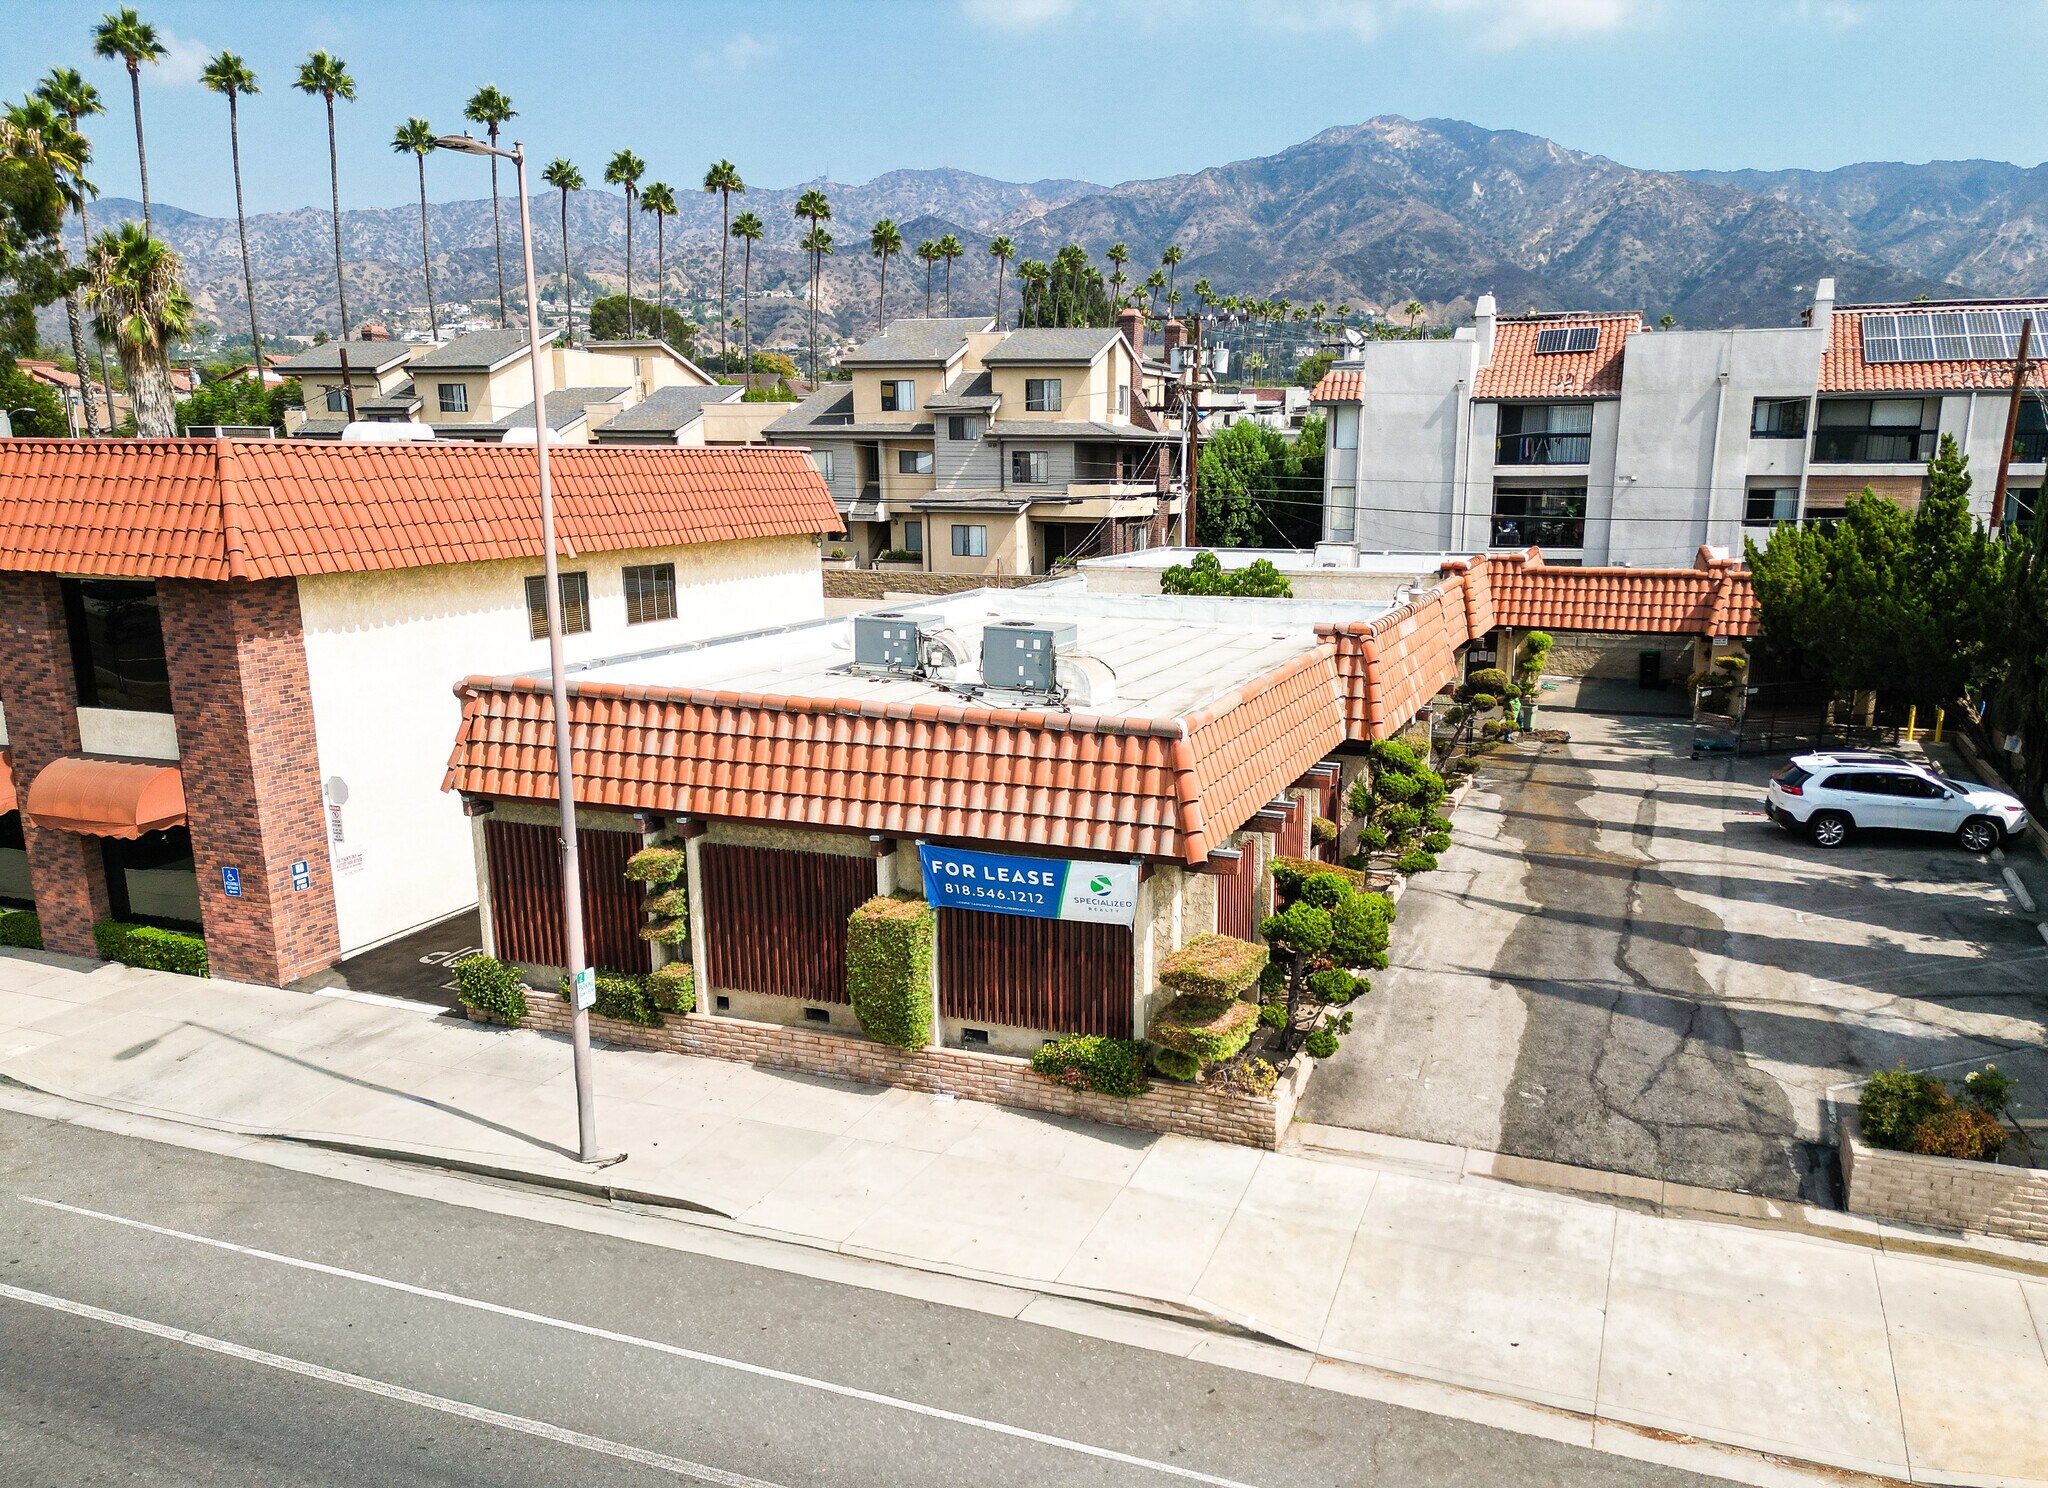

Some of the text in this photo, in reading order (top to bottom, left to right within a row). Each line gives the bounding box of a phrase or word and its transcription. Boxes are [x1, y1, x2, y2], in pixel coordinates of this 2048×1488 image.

[931, 860, 1055, 887] FOR LEASE
[945, 882, 1044, 905] 818.546.1212
[1073, 896, 1133, 908] SPECIALIZED
